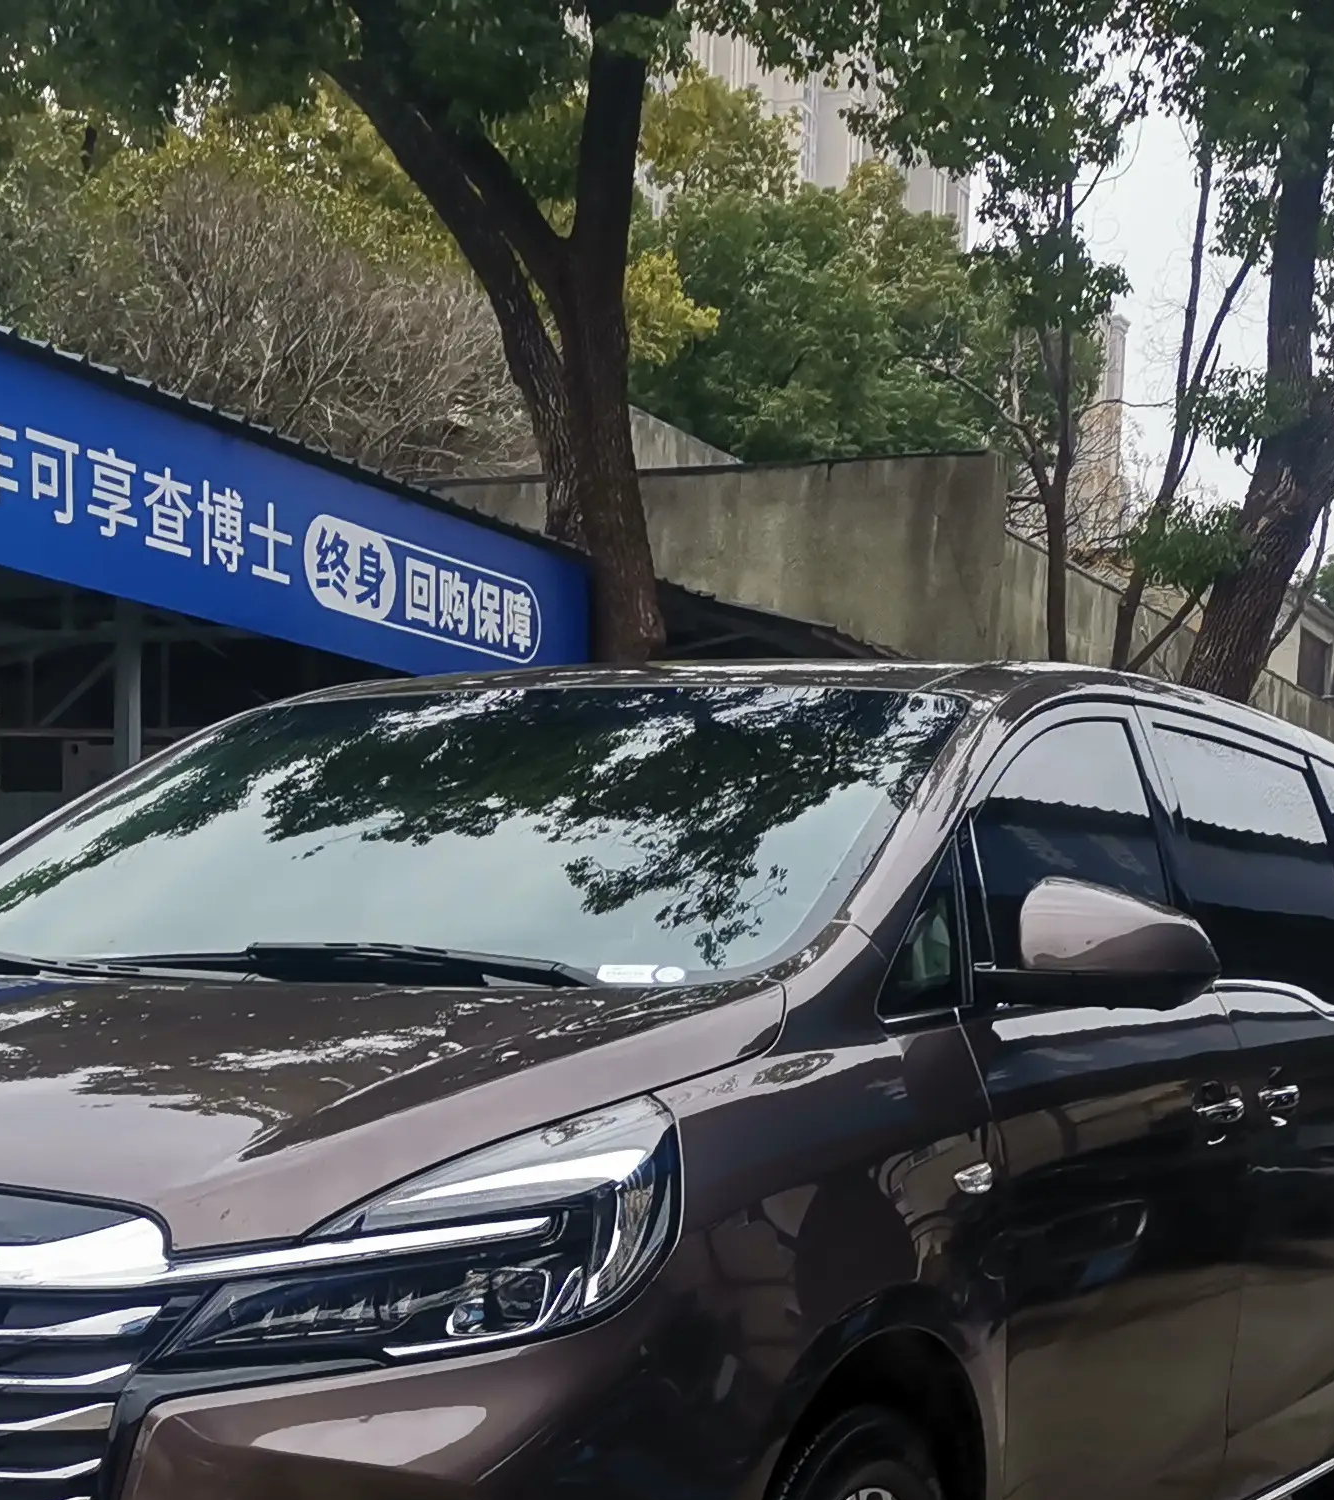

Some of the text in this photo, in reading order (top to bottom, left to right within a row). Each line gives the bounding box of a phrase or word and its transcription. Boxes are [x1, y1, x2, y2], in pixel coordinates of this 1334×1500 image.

[314, 524, 388, 611] 终身
[405, 557, 532, 654] 回购保障
